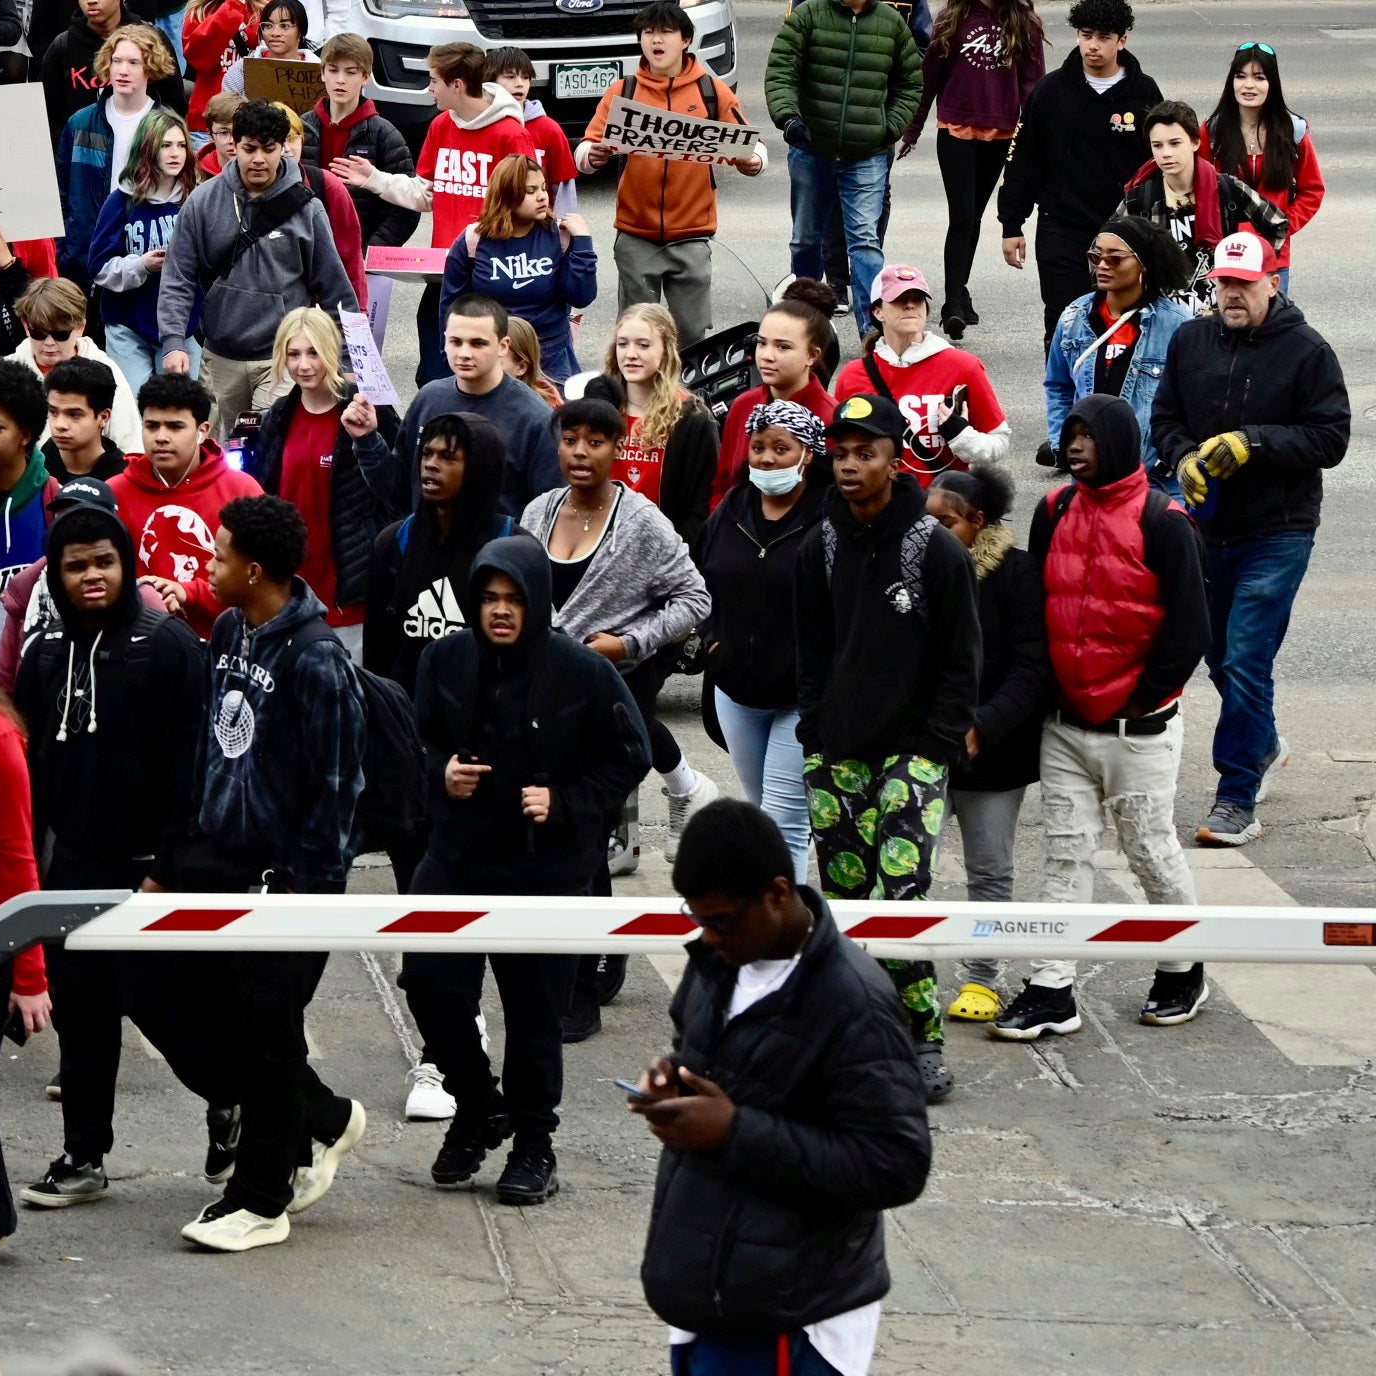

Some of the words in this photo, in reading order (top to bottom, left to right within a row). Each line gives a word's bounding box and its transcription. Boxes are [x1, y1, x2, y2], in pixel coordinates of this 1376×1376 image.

[605, 124, 718, 153] PRAYERS
[621, 107, 759, 145] THOUGHT
[434, 148, 493, 186] EAST
[1224, 244, 1247, 253] EAST
[490, 252, 553, 280] Nike
